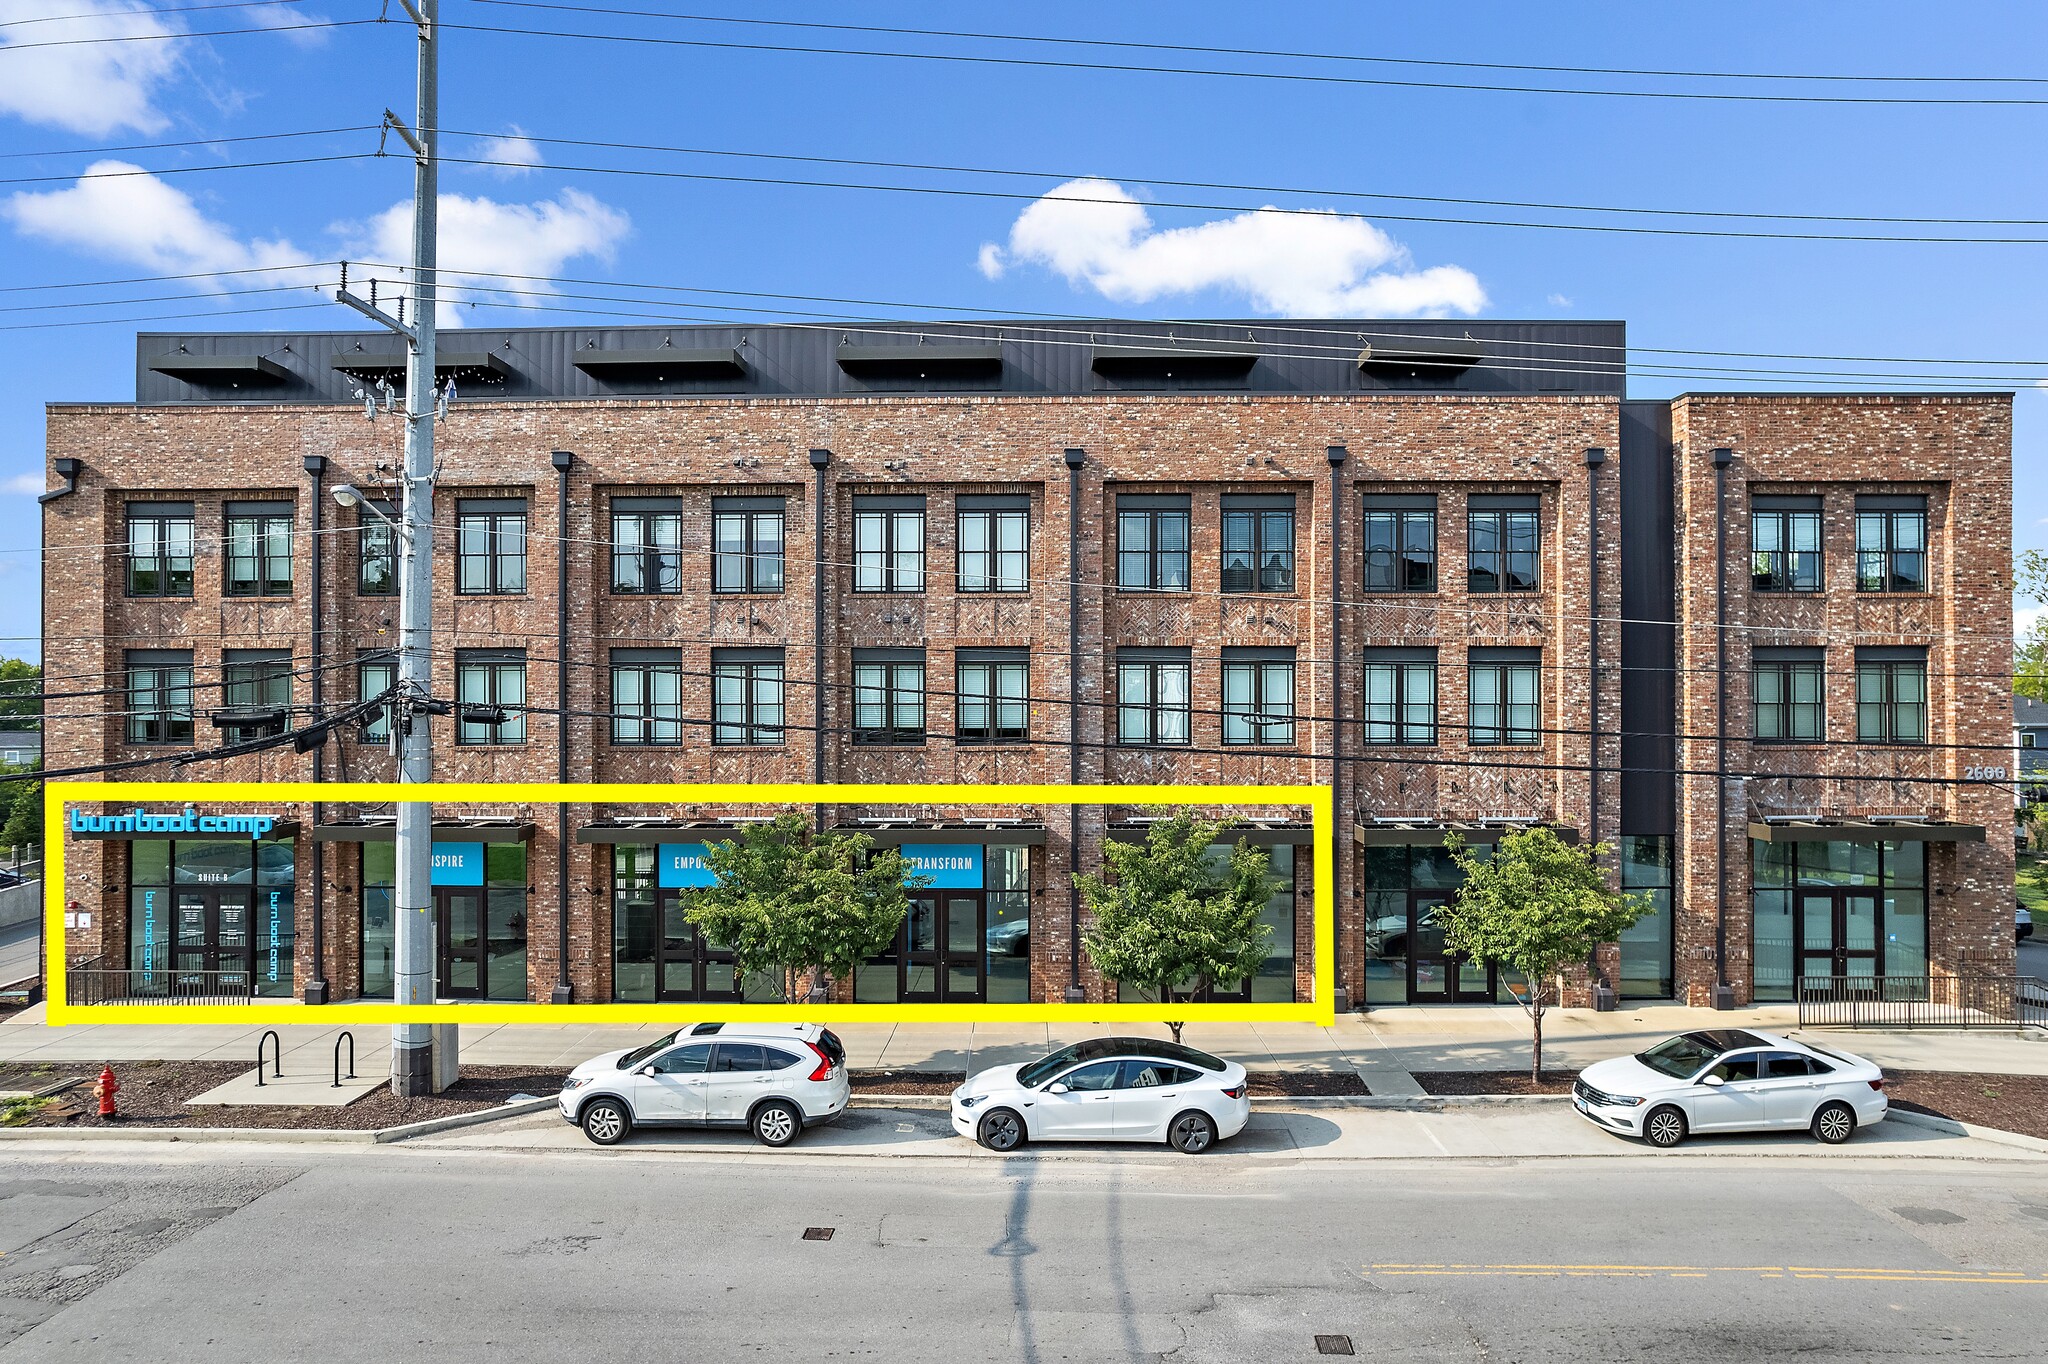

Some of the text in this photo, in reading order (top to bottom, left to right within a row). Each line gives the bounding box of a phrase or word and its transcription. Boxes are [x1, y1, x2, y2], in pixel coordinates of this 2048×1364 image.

[1964, 766, 2006, 780] 2600
[71, 808, 273, 839] burn boot camp
[431, 855, 463, 867] SPIRE
[674, 856, 706, 869] EMPO
[911, 857, 972, 870] TRANSFORM
[198, 873, 228, 882] SUITE B
[145, 891, 156, 918] burn
[145, 919, 156, 946] boot
[267, 892, 281, 982] burn boot camp
